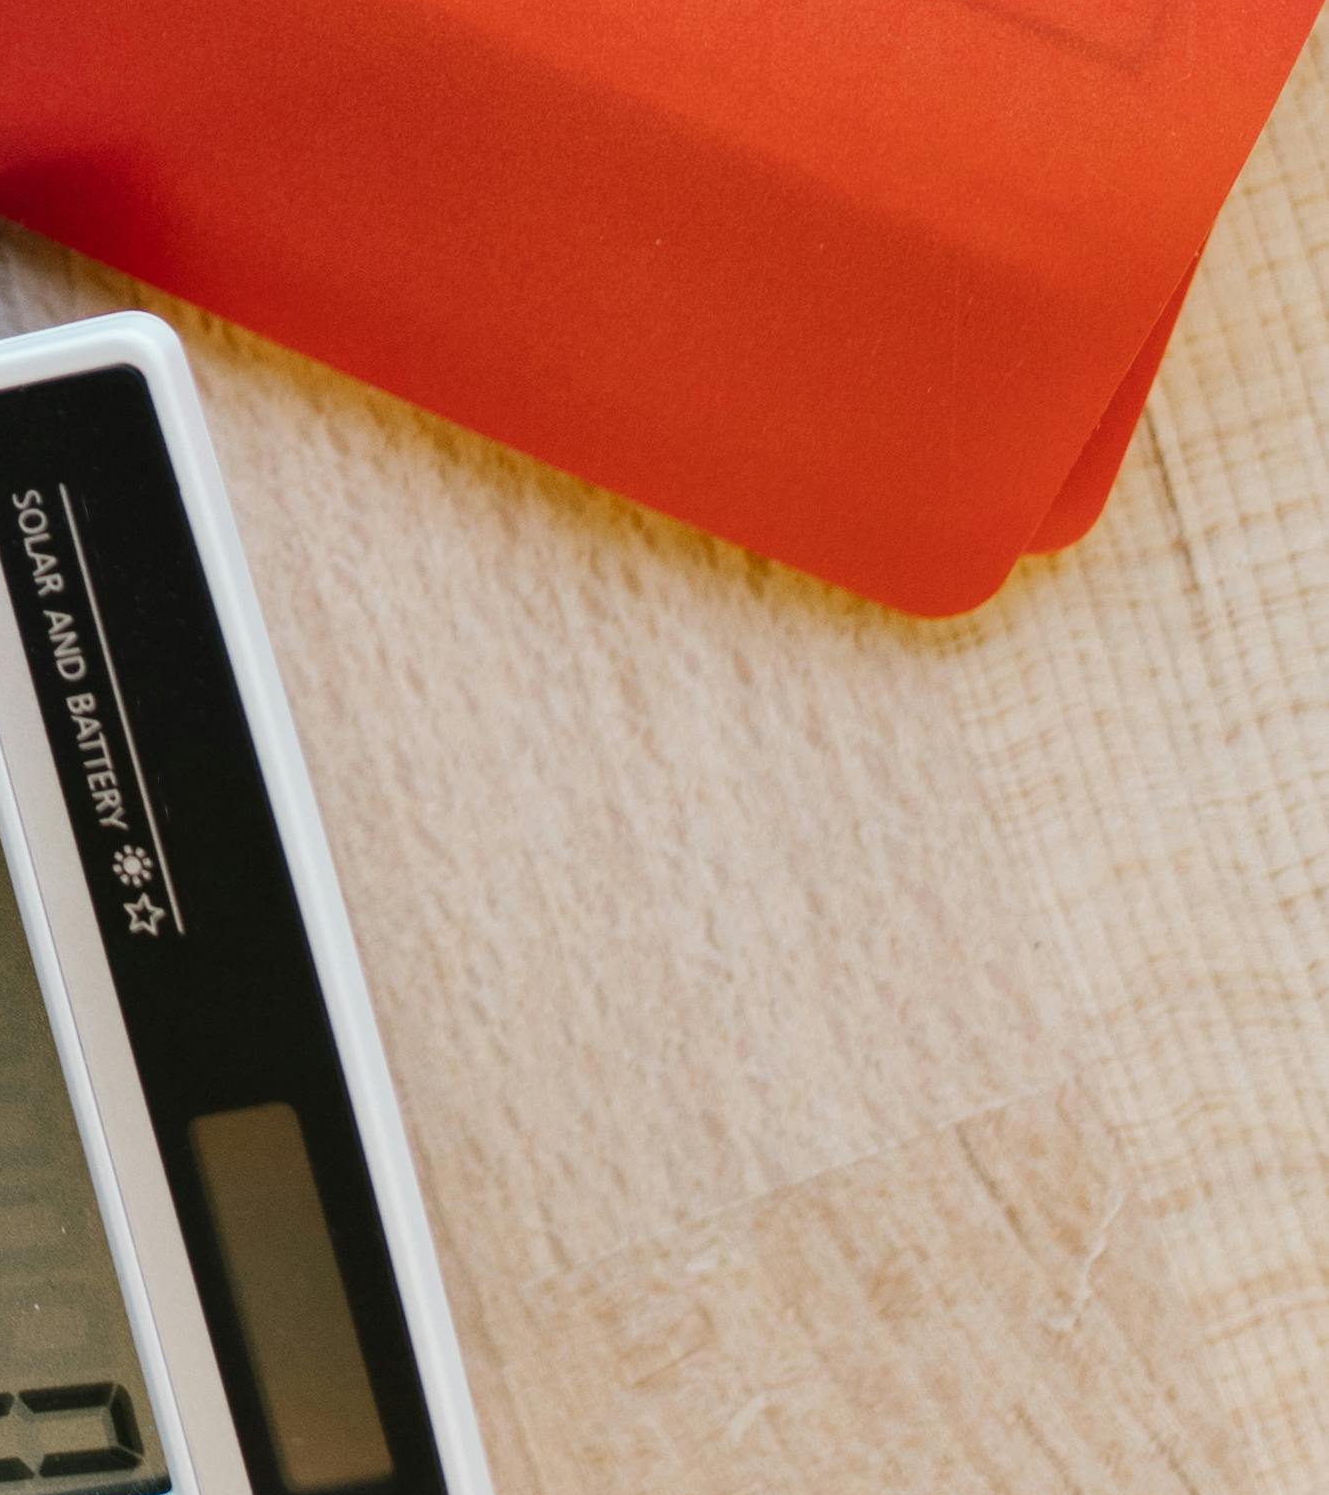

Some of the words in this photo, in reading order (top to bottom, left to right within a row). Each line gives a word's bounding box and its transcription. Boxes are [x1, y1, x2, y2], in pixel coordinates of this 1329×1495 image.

[12, 489, 64, 597] SOLAR
[43, 609, 88, 683] AND
[65, 692, 129, 832] BATTERY
